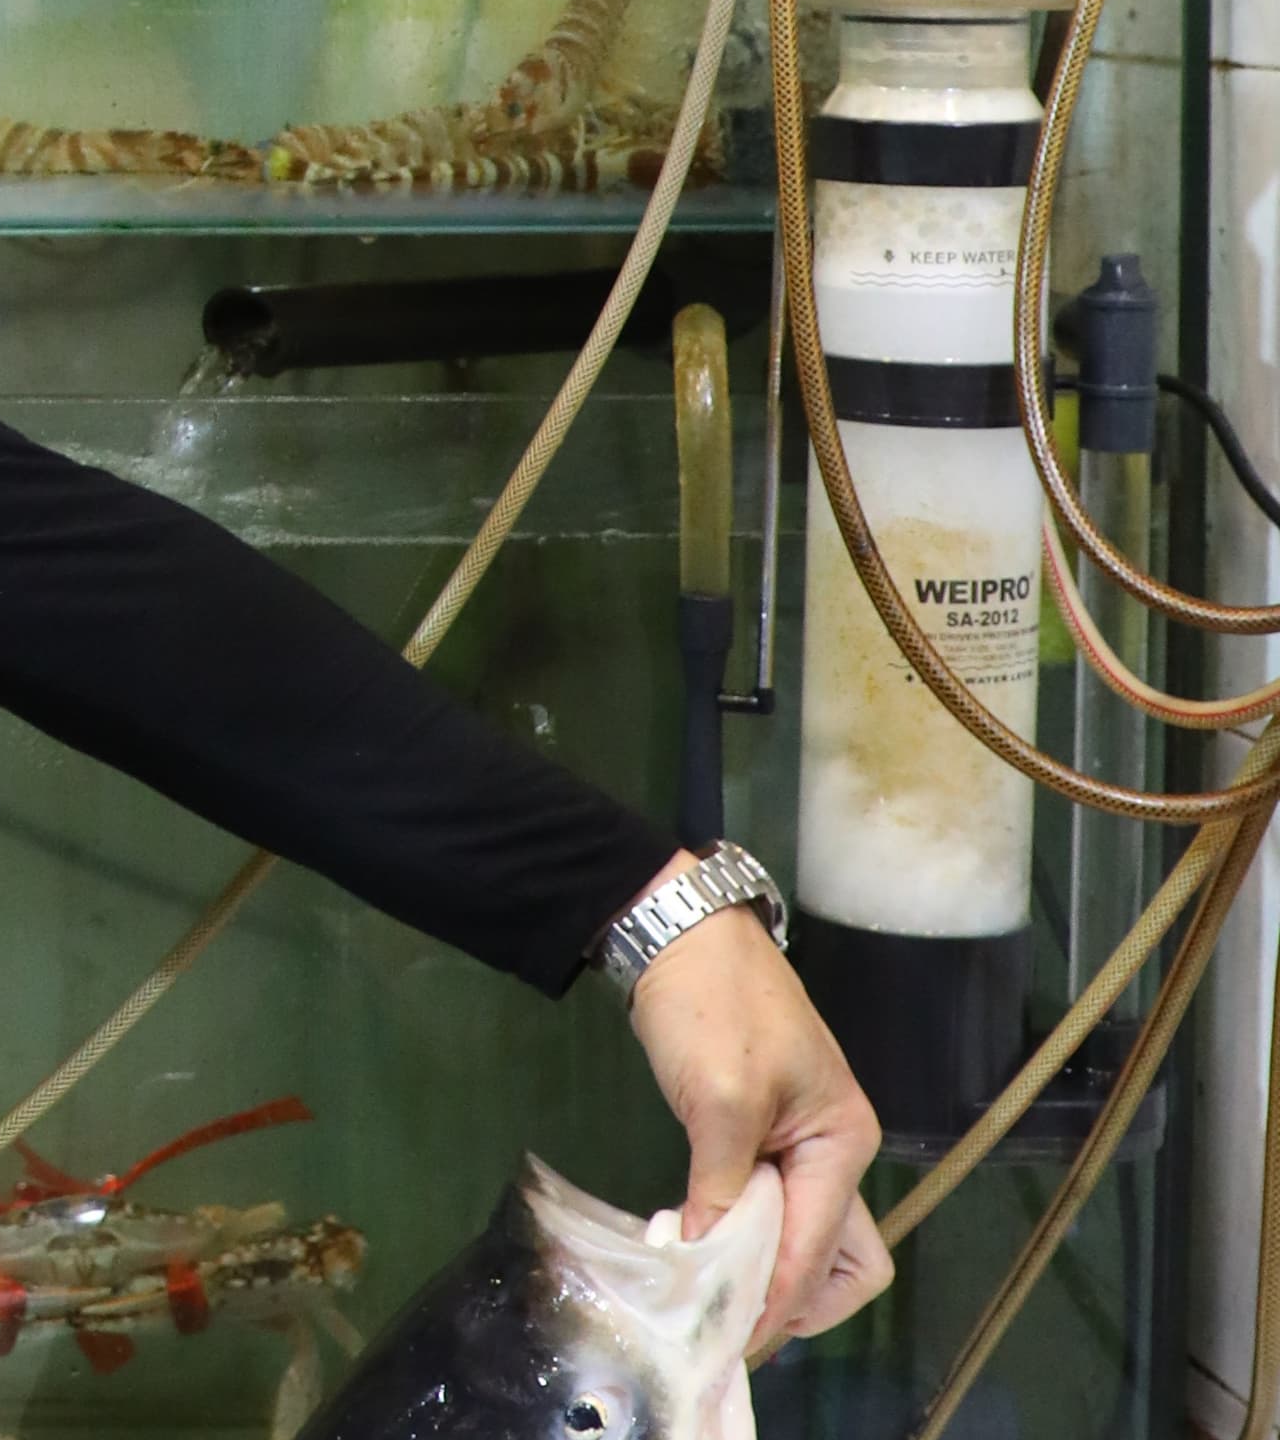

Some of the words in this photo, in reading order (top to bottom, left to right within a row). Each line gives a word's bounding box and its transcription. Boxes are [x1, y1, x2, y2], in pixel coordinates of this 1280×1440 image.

[909, 250, 957, 264] KEEP
[962, 249, 1015, 264] WATER
[914, 575, 1030, 605] WEIPRO
[946, 608, 1019, 627] SA-2012
[965, 675, 1008, 684] WATER
